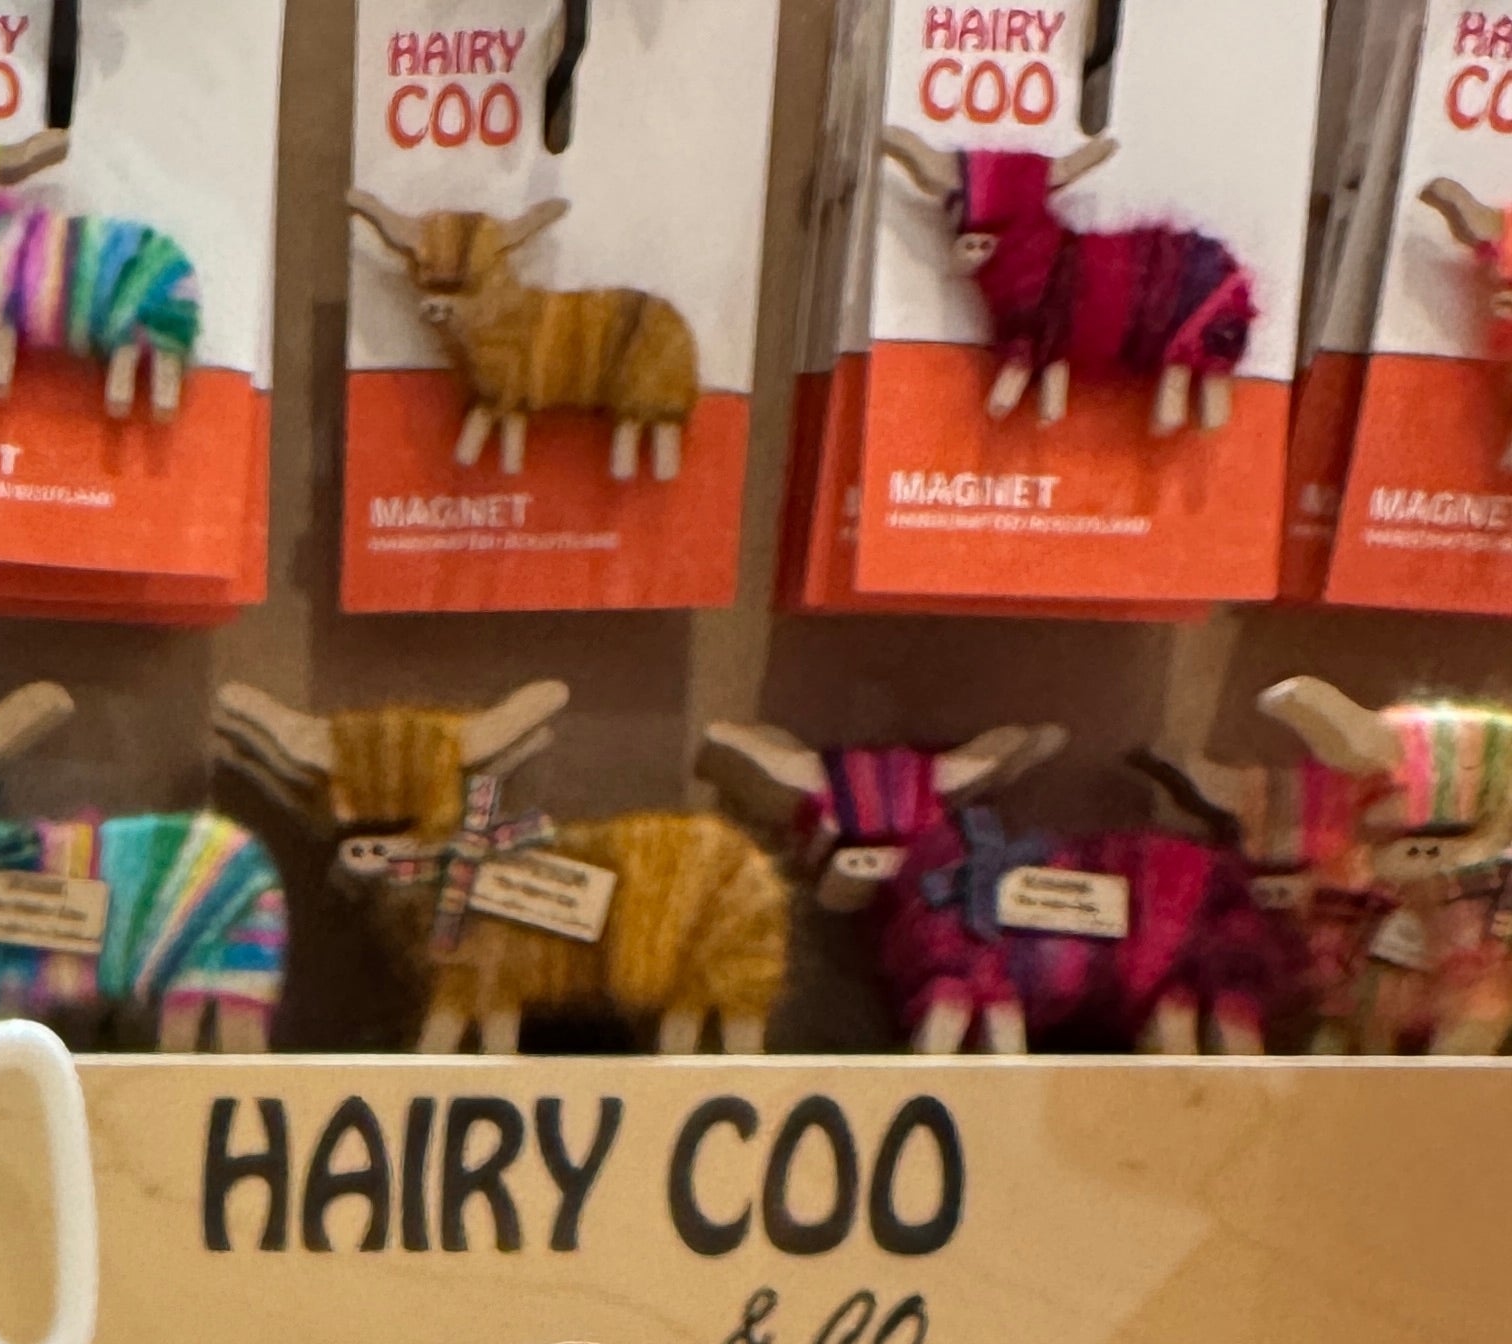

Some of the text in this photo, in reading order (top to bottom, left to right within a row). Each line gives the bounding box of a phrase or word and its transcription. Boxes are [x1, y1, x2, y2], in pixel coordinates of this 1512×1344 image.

[388, 28, 526, 76] HAIRY
[923, 5, 1065, 53] HAIRY
[386, 83, 522, 148] COO
[919, 58, 1055, 125] COO
[370, 492, 534, 529] MAGNET
[889, 469, 1061, 509] MAGNET
[201, 1094, 966, 1257] HAIRY COO
